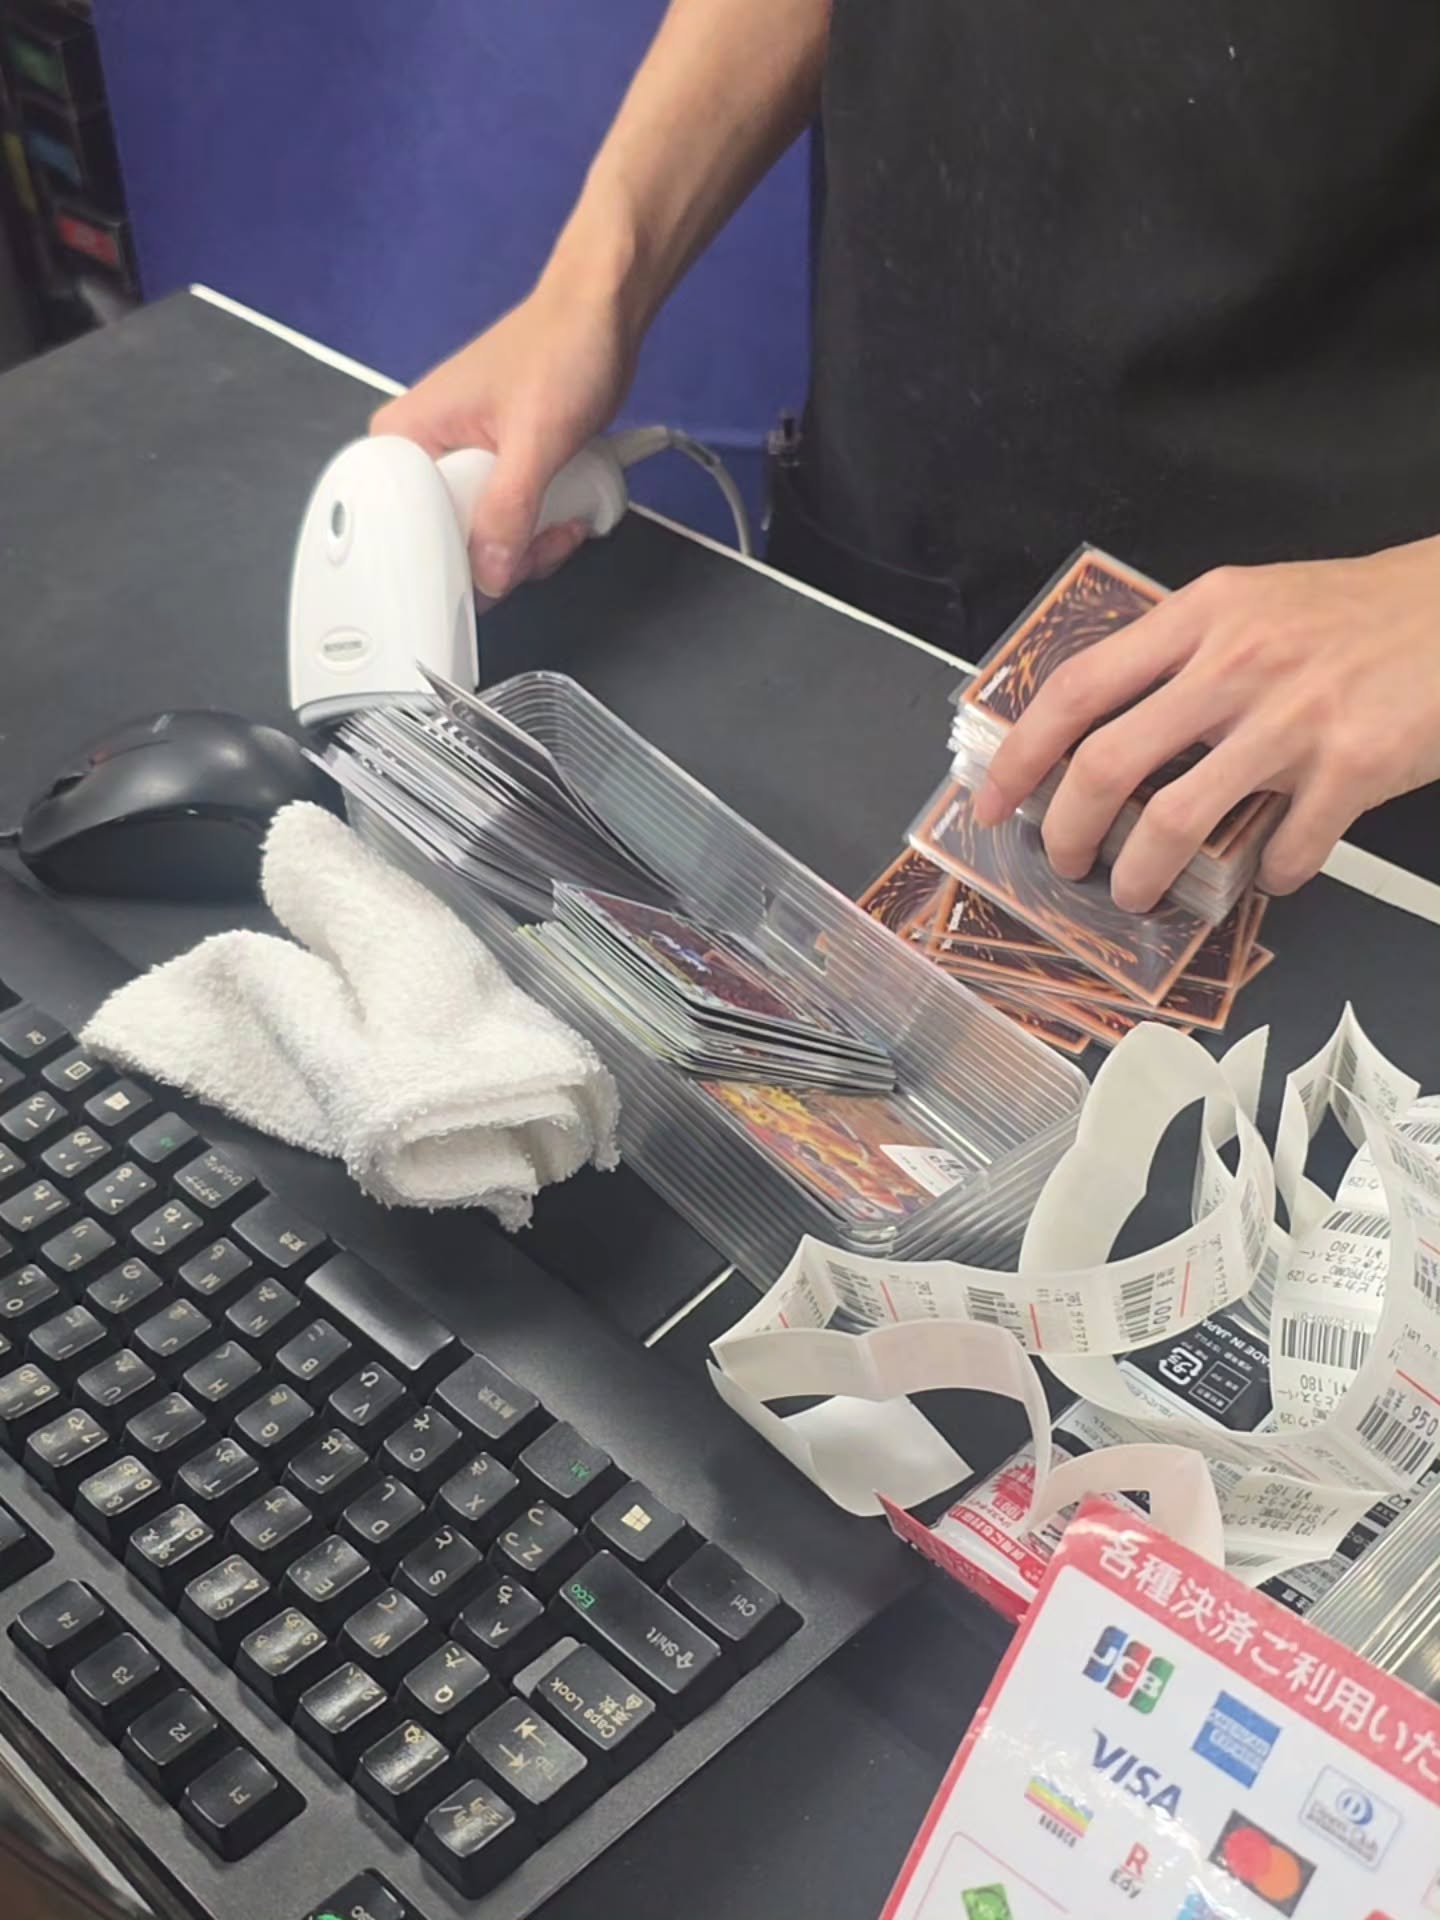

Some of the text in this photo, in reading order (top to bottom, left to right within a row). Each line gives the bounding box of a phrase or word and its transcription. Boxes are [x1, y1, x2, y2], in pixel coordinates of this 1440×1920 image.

[73, 1132, 91, 1146] め
[123, 1265, 141, 1278] の
[200, 1274, 220, 1288] M
[110, 1294, 128, 1308] K
[249, 1316, 267, 1330] N
[1201, 1318, 1233, 1339] JAPA
[1230, 1336, 1247, 1350] IN
[301, 1358, 318, 1372] B
[208, 1379, 227, 1393] H
[361, 1372, 379, 1387] ひ
[104, 1387, 121, 1401] U
[353, 1403, 369, 1418] V
[414, 1414, 429, 1431] そ
[1407, 1405, 1439, 1437] 950
[261, 1422, 278, 1437] G
[152, 1432, 169, 1444] Y
[409, 1448, 425, 1462] C
[471, 1460, 487, 1475] さ
[203, 1479, 221, 1492] T
[315, 1472, 335, 1486] F
[382, 1484, 397, 1501] し
[265, 1498, 287, 1514] す
[465, 1494, 485, 1511] X
[371, 1520, 389, 1534] D
[258, 1528, 276, 1543] R
[436, 1531, 452, 1549] と
[522, 1544, 542, 1561] Z
[429, 1570, 446, 1585] S
[314, 1579, 335, 1595] E
[498, 1586, 512, 1604] ち
[569, 1583, 596, 1610] Eco
[730, 1595, 757, 1617] Ctrl
[57, 1611, 79, 1629] F4
[490, 1622, 508, 1638] A
[370, 1632, 390, 1648] W
[646, 1627, 683, 1659] Shift
[445, 1648, 466, 1669] た
[112, 1667, 134, 1684] F3
[435, 1685, 453, 1702] Q
[550, 1677, 618, 1738] Caps Lock
[169, 1723, 192, 1742] F2
[1092, 1728, 1184, 1818] VISA
[229, 1786, 250, 1804] F1
[1125, 1842, 1150, 1877] R
[1109, 1869, 1142, 1900] Edy
